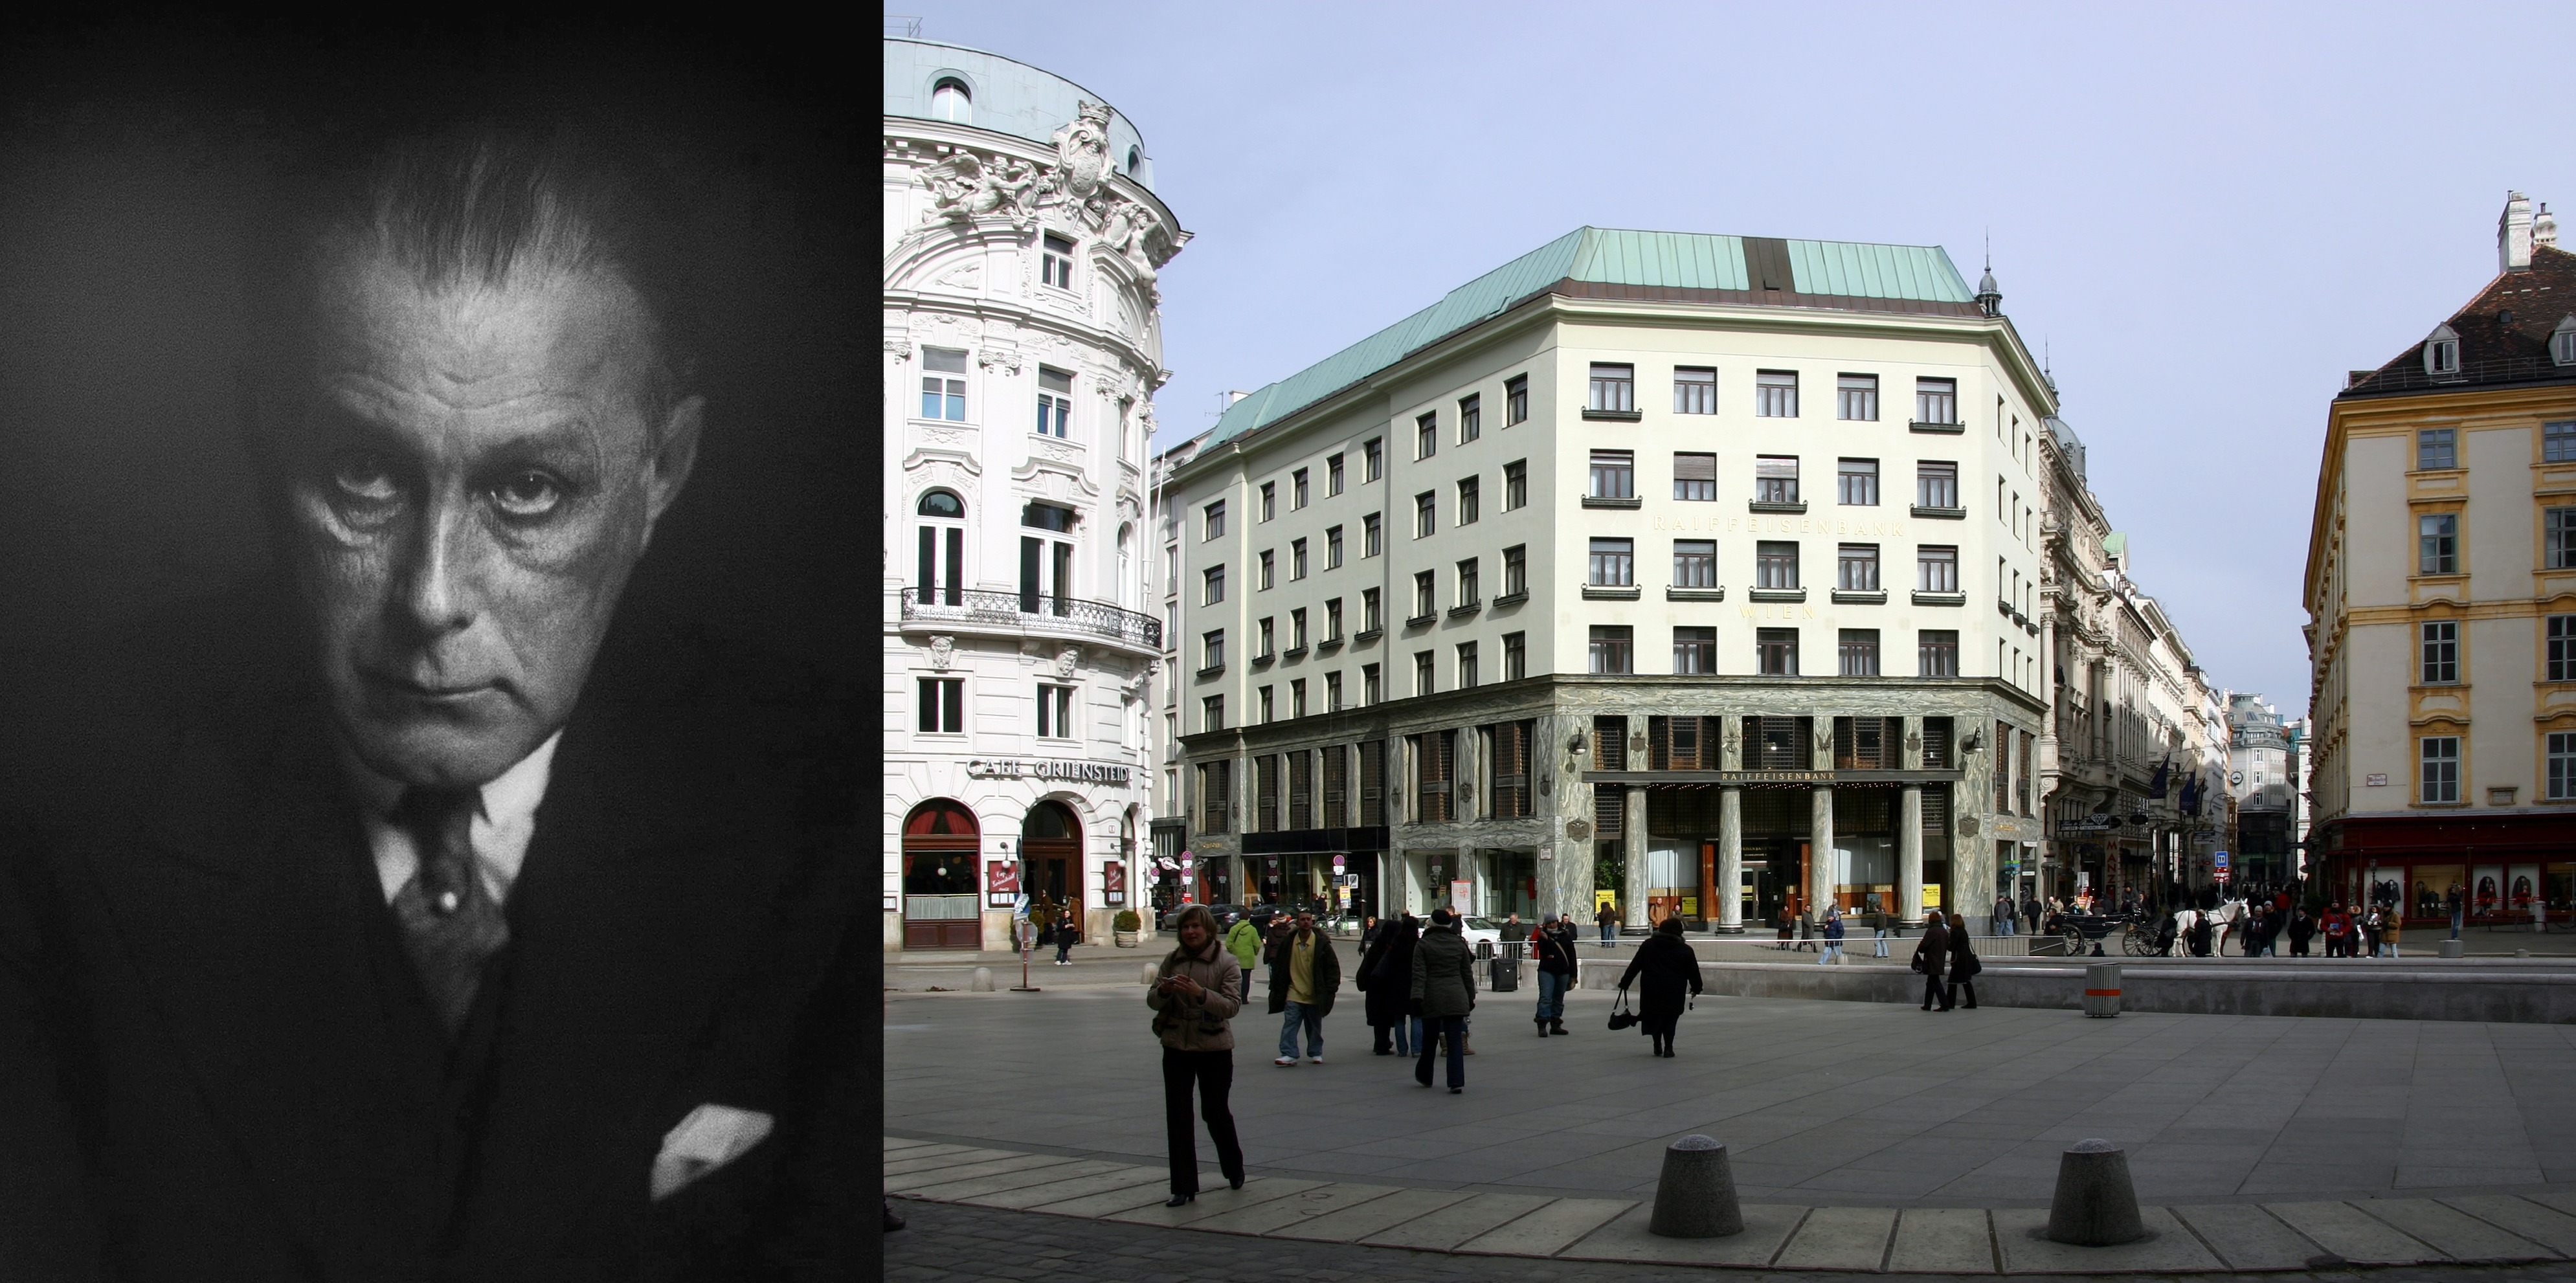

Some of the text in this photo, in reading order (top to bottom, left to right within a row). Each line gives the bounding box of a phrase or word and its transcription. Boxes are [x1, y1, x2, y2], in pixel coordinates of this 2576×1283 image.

[1653, 516, 1905, 537] RAIFFEISENBANK
[1738, 603, 1815, 619] WIEN
[966, 758, 1023, 776] CAFE
[2107, 840, 2117, 884] MANZ
